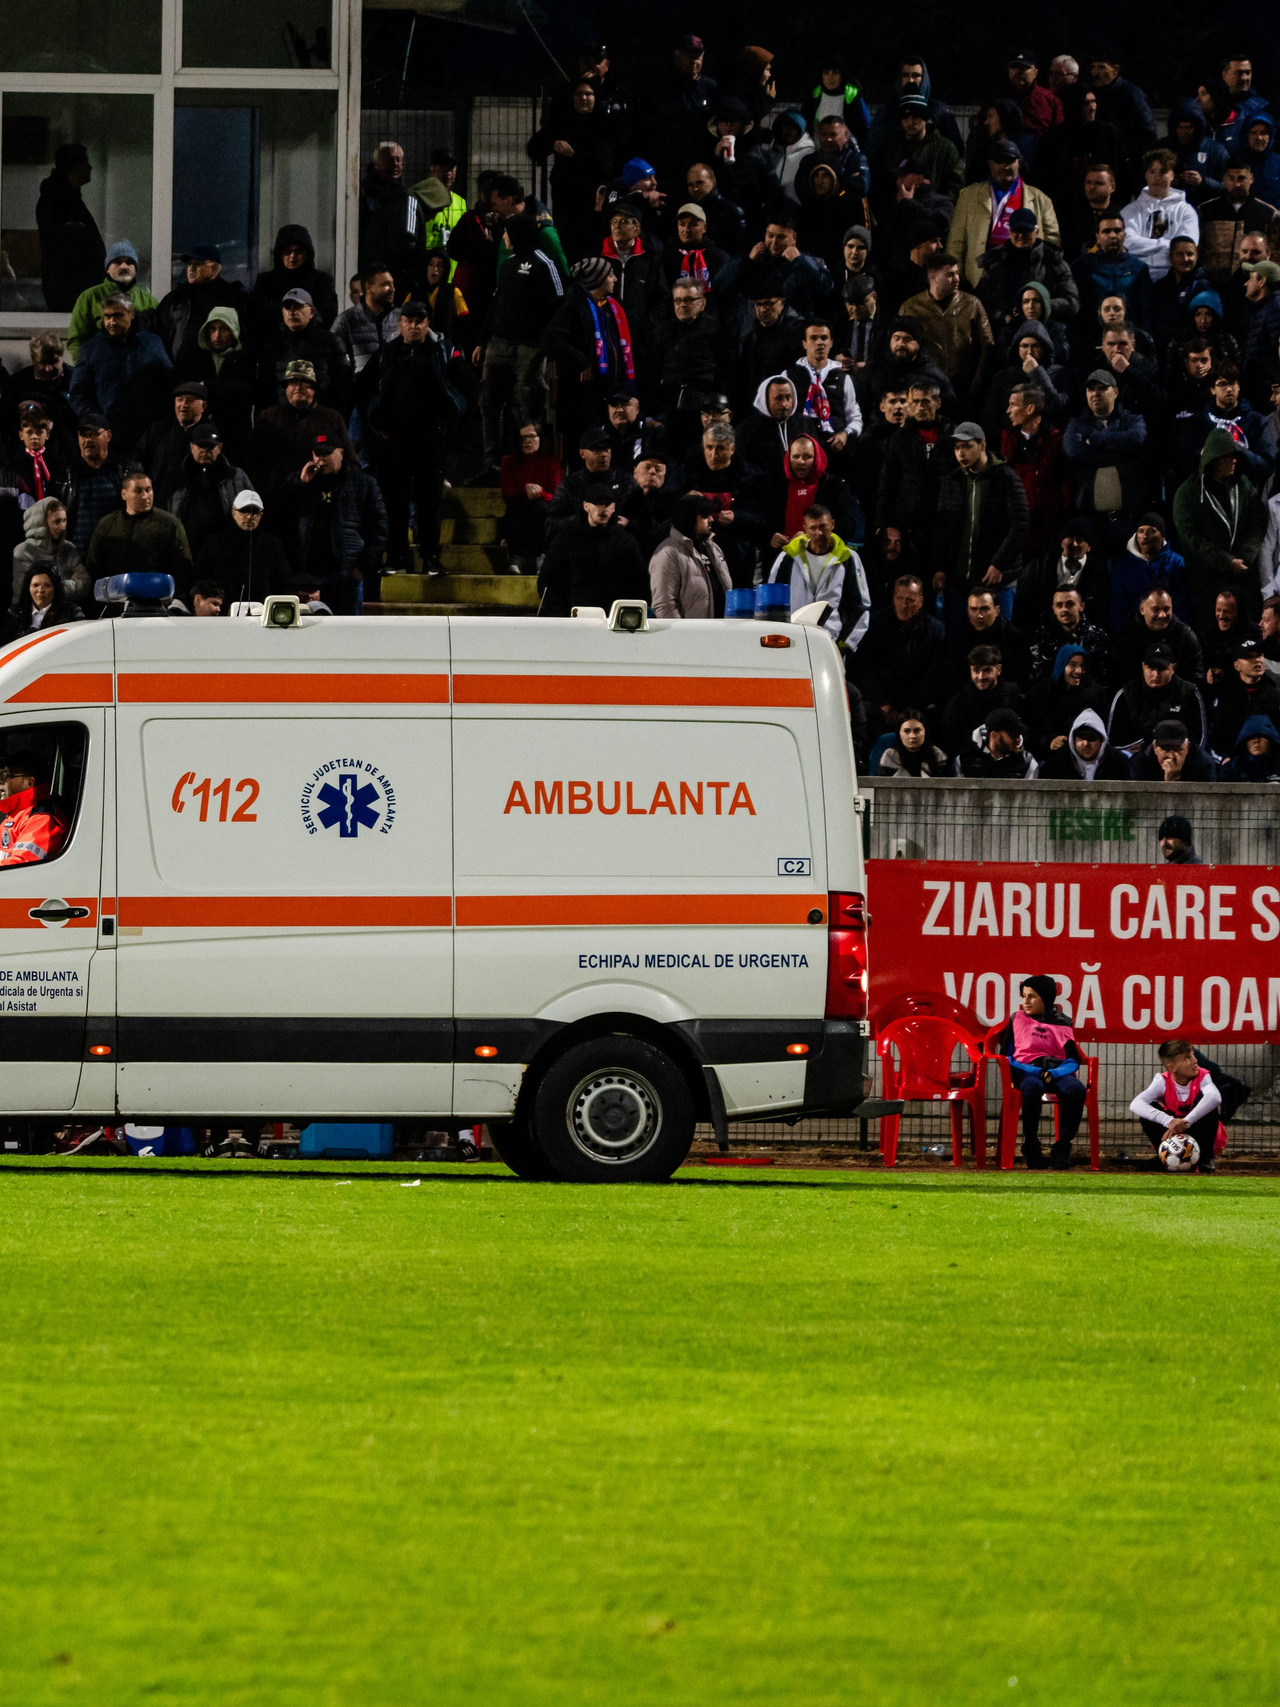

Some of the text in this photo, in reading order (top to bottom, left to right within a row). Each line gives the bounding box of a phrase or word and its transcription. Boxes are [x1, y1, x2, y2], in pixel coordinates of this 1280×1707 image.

[192, 778, 260, 822] 112
[300, 758, 396, 834] SERVICIUL JUDETEAN DE AMBULANTA
[503, 780, 757, 816] AMBULANTA
[783, 860, 805, 874] C2
[921, 880, 1095, 938] ZIARUL
[1109, 883, 1236, 940] CARE
[578, 954, 809, 969] ECHIPAJ MEDICAL DE URGENTA
[0, 970, 13, 982] DE
[16, 970, 78, 982] AMBULANTA
[26, 986, 38, 996] de
[40, 986, 74, 999] Urgenta
[76, 986, 84, 996] si
[1122, 974, 1184, 1031] CU
[6, 1001, 37, 1012] Asistat
